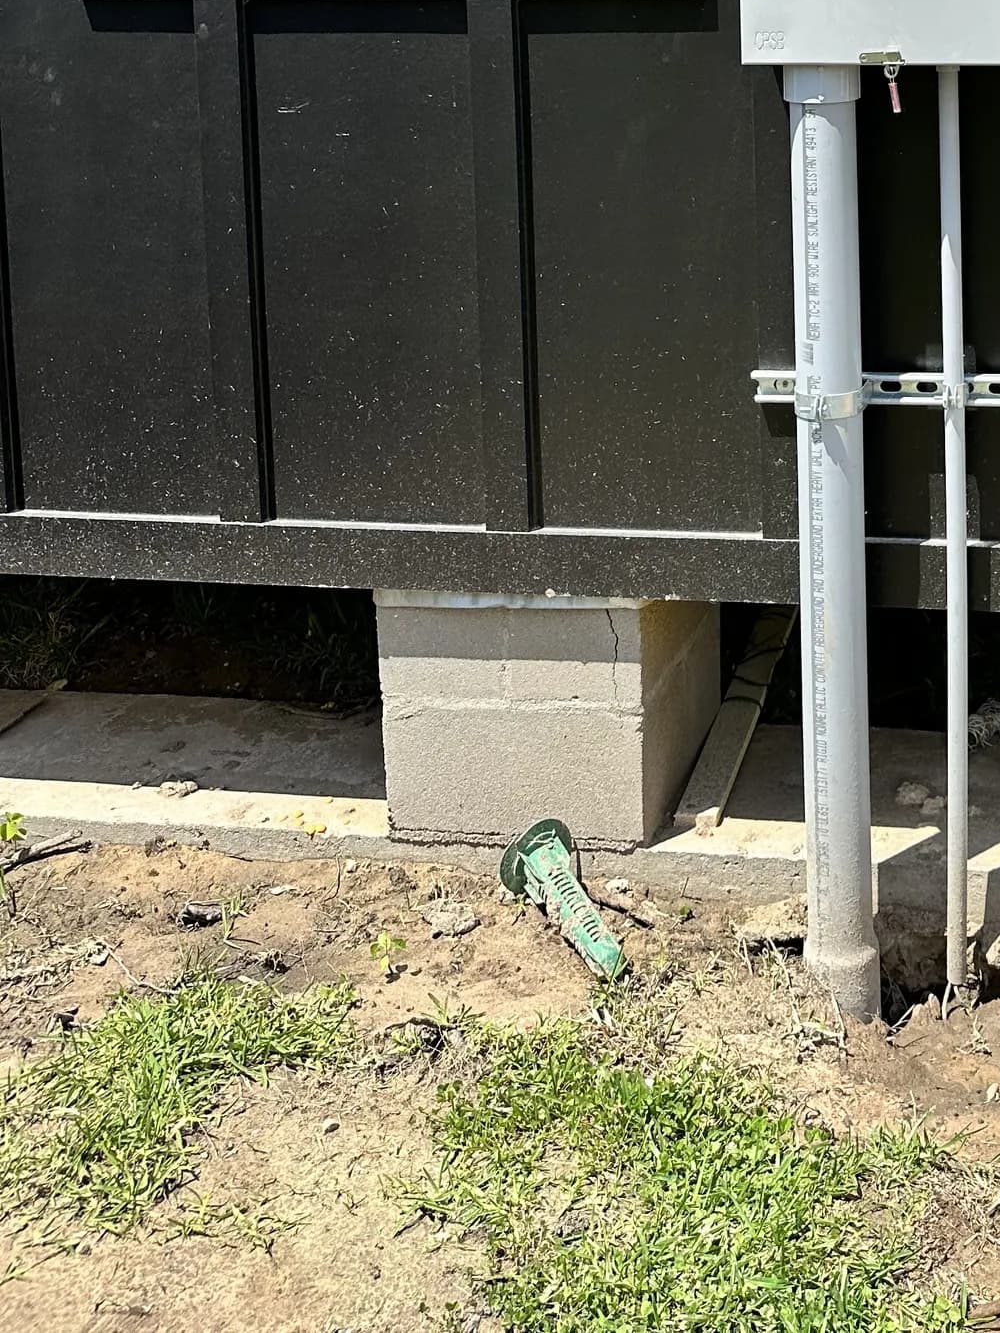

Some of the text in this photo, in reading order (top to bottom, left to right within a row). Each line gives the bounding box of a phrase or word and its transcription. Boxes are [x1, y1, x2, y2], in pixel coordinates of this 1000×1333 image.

[806, 127, 817, 151] 49413
[806, 155, 818, 197] RESISTANT
[806, 200, 818, 237] SUNLIGHT
[807, 242, 819, 261] WIRE
[808, 282, 819, 297] MAX
[808, 300, 820, 318] TC-2
[808, 322, 820, 341] NEMA
[809, 375, 821, 390] PVC
[811, 449, 822, 467] WALL
[811, 471, 822, 494] HEAVY
[812, 497, 823, 522] EXTRA
[812, 525, 823, 575] UNDERGROUND
[813, 579, 824, 593] AND
[813, 597, 825, 648] ABOVEGROUND
[815, 651, 826, 683] CONDUIT
[816, 687, 827, 736] NONMETALLIC
[816, 741, 827, 764] RIGID
